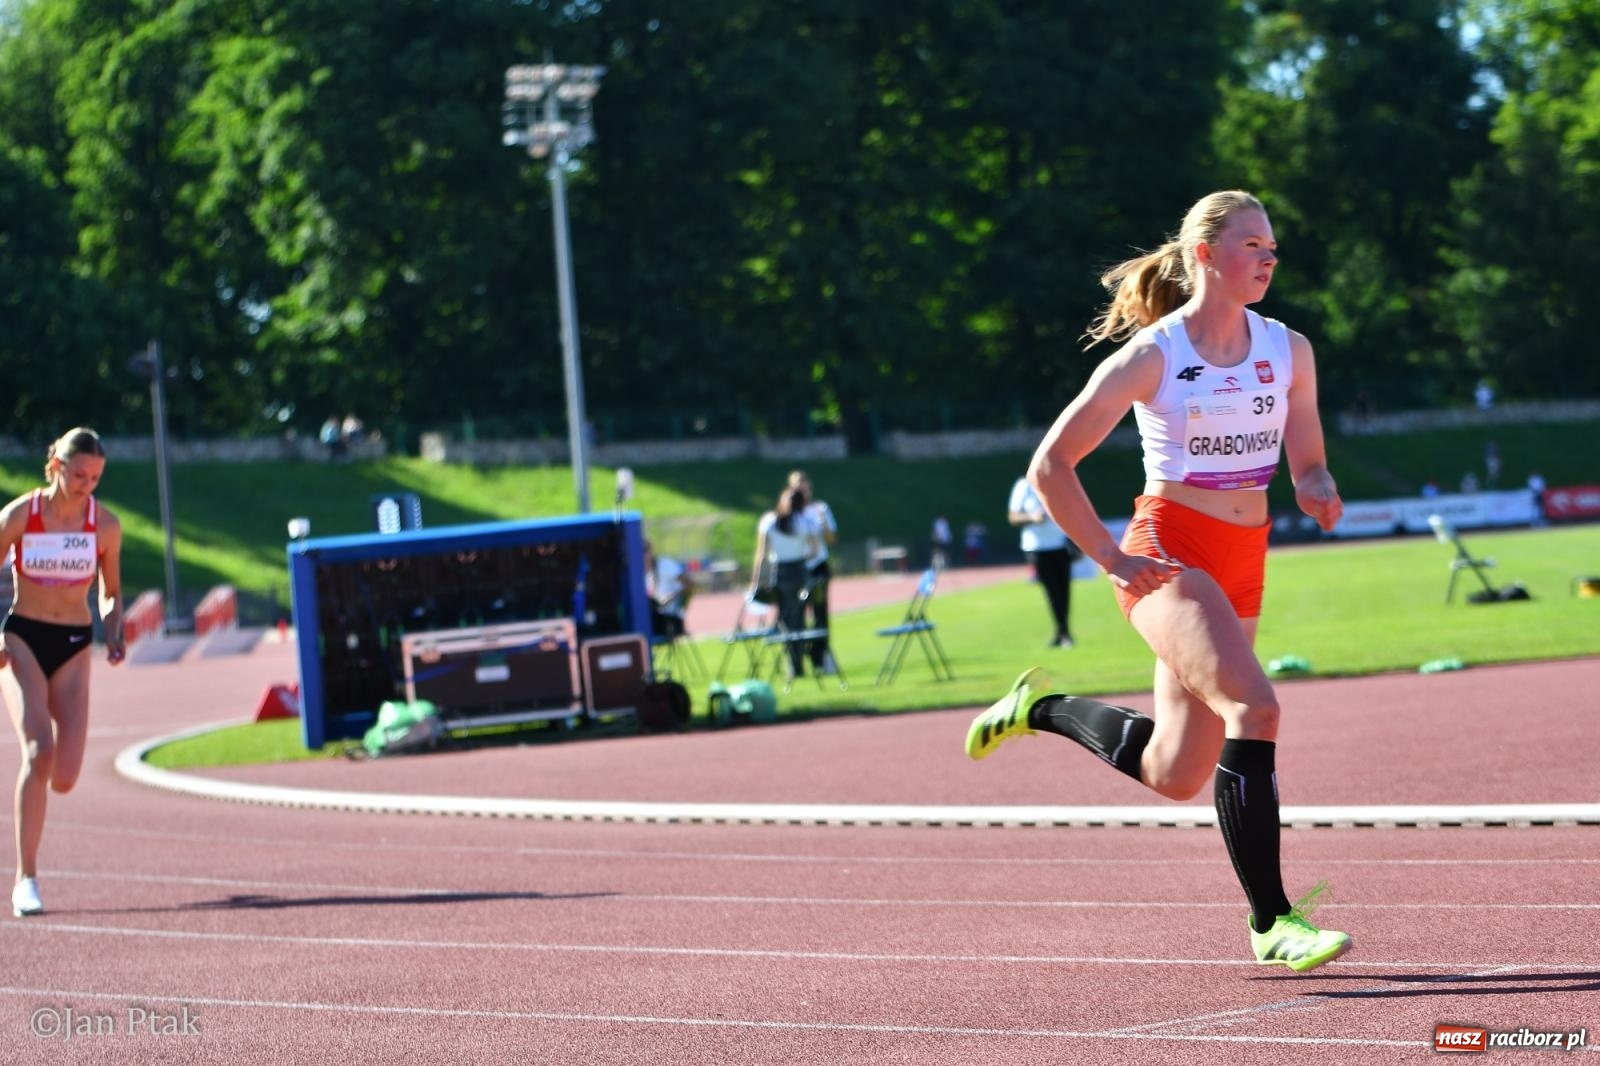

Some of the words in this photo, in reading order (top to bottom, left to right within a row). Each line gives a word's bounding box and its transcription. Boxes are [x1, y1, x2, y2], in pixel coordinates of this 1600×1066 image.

[1176, 366, 1205, 382] 4F
[1252, 395, 1275, 415] 39
[1188, 429, 1279, 456] GRABOWSKA
[64, 537, 89, 550] 206
